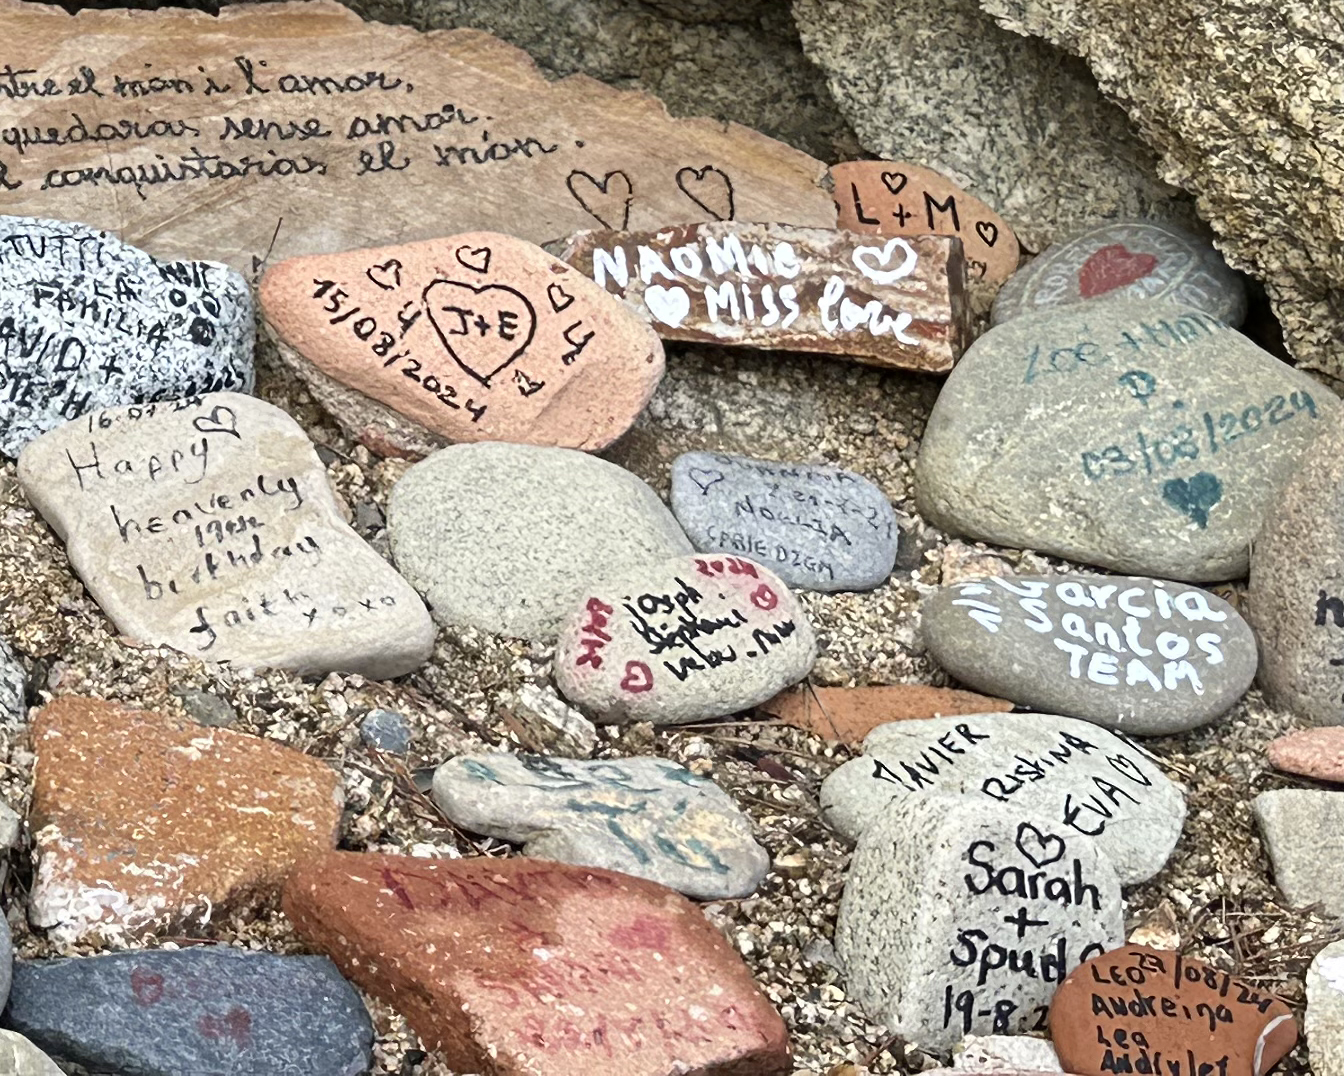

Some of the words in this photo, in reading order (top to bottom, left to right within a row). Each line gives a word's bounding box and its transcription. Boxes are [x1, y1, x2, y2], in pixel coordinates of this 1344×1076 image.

[218, 116, 332, 141] sense
[851, 181, 882, 226] L
[922, 190, 962, 233] M
[63, 436, 211, 491] Happy
[109, 473, 306, 545] heavenly
[1053, 637, 1206, 696] TEAM
[1062, 775, 1142, 836] EVA
[963, 840, 1101, 911] Sarah
[1002, 906, 1051, 940] +
[950, 928, 1068, 987] Spud
